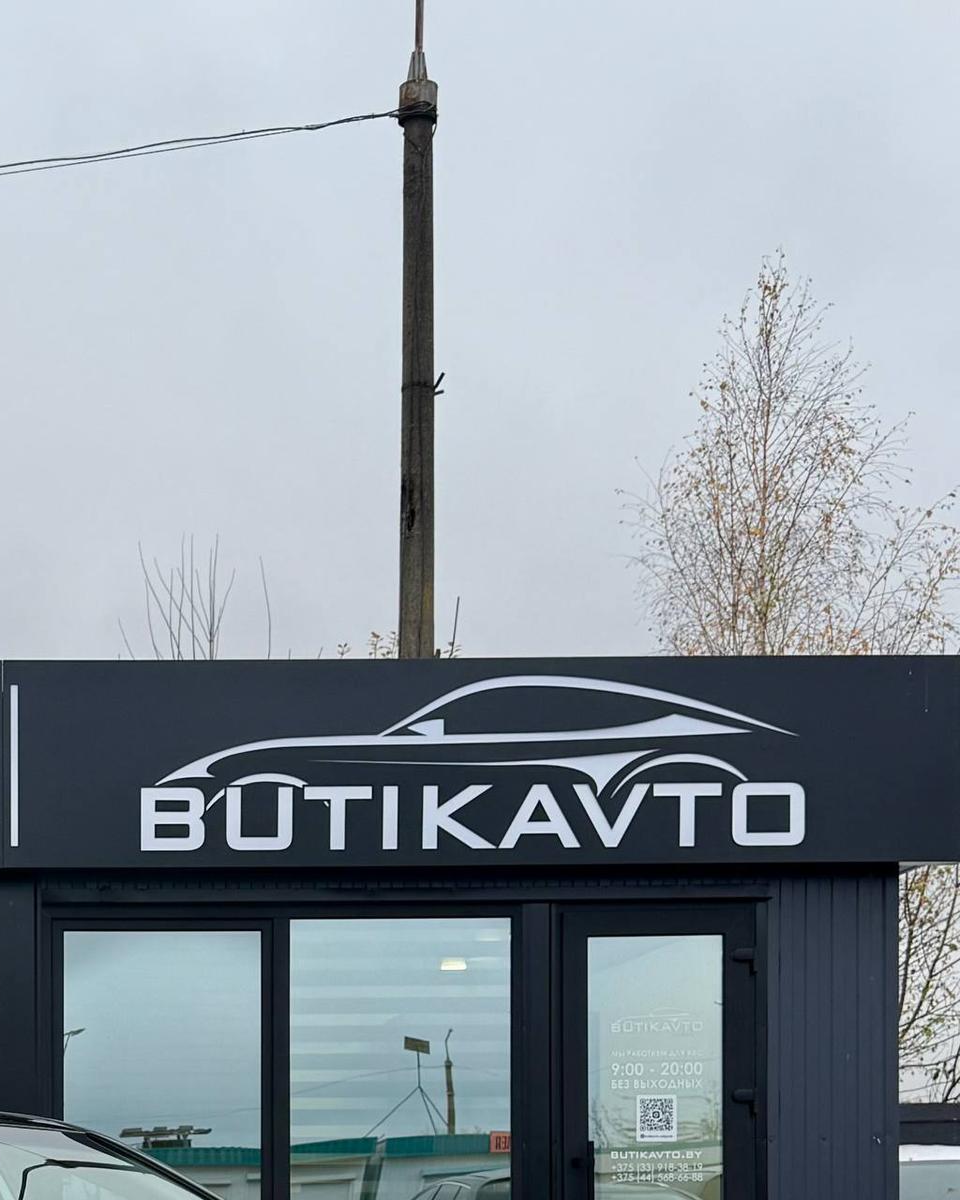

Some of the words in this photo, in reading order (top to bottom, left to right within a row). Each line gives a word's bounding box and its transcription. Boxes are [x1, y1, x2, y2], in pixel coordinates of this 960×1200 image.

[140, 782, 806, 851] BUTIKAVTO
[610, 1021, 704, 1033] BUTIKAVTO
[611, 1062, 644, 1076] 9:00
[660, 1061, 703, 1076] 20:00
[611, 1079, 629, 1089] БЕЗ
[633, 1079, 703, 1089] ВЫХОДНЫХ
[610, 1150, 702, 1159] BUTIKAVTO.BY
[612, 1163, 634, 1172] +375
[637, 1162, 654, 1174] (33)
[612, 1173, 634, 1182] +375
[637, 1173, 654, 1184] (44)
